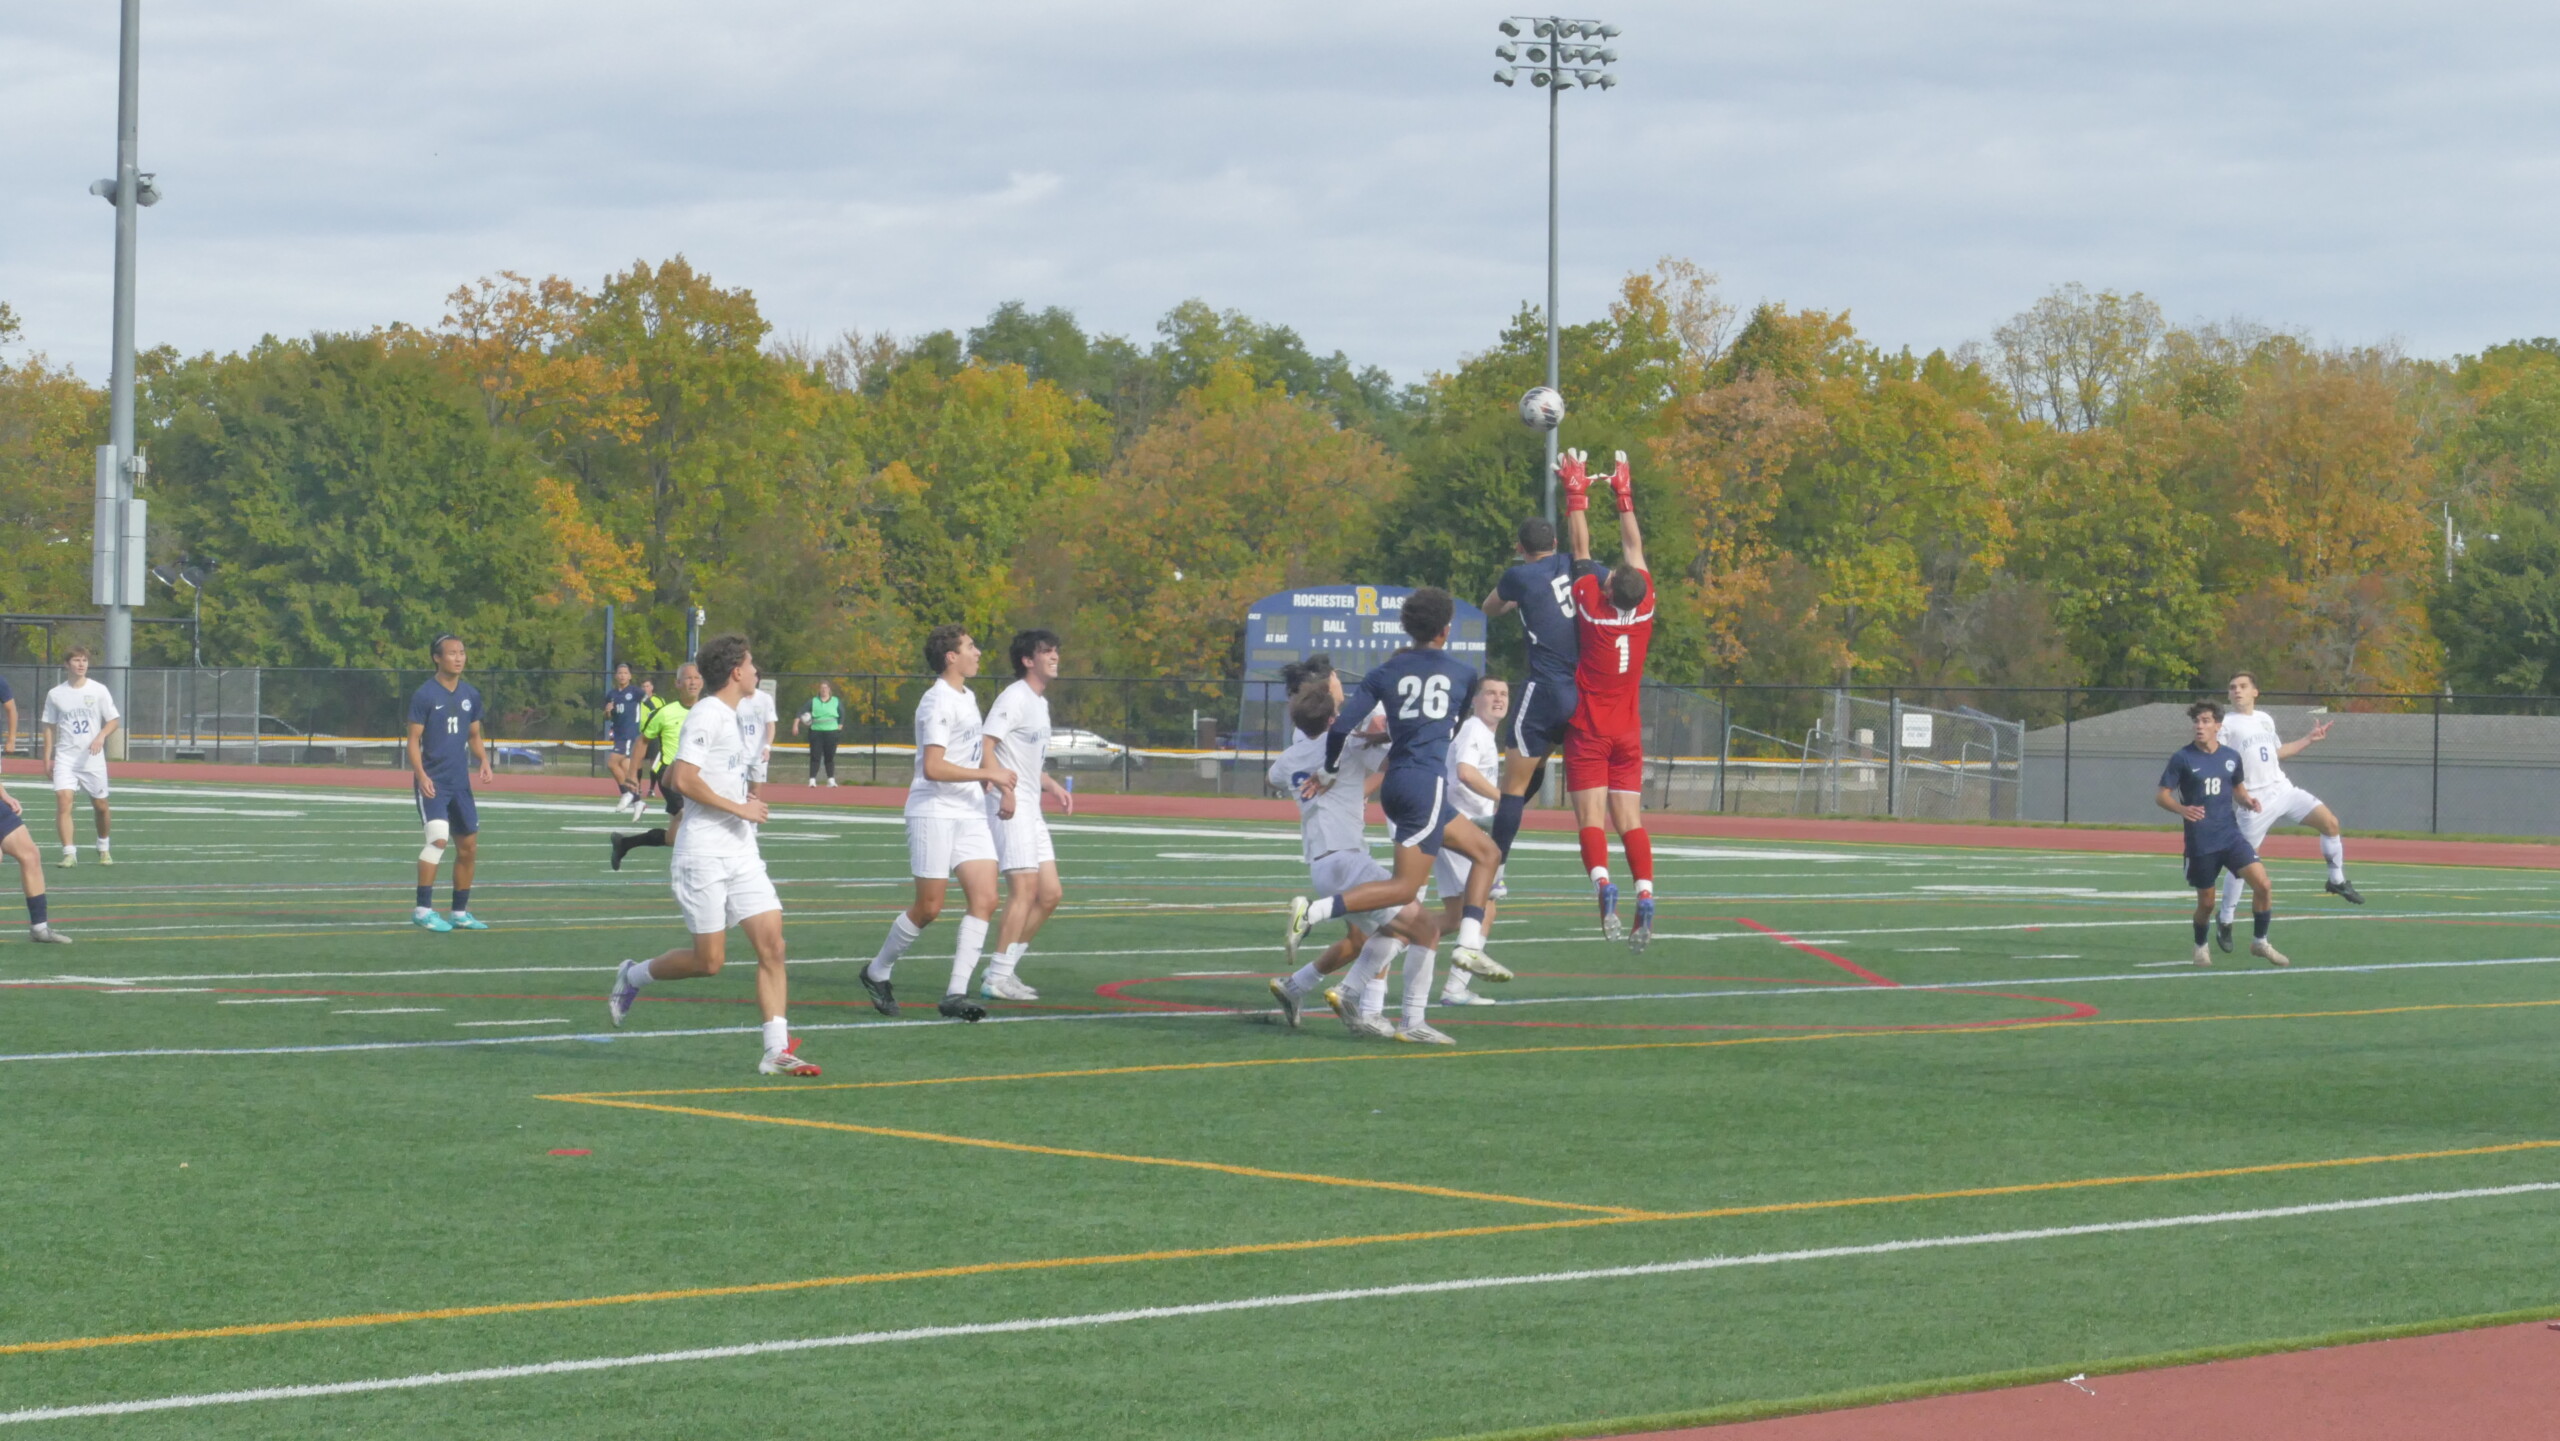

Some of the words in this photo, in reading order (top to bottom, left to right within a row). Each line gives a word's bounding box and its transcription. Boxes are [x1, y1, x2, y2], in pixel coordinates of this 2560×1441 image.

[1293, 594, 1355, 608] ROCHESTER
[1355, 586, 1379, 615] R
[1551, 574, 1576, 618] 5
[1323, 620, 1347, 633] BALL
[1265, 634, 1274, 643] AT
[1275, 634, 1288, 643] BAT
[1311, 639, 1316, 647] 1
[1323, 639, 1328, 648] 2
[1335, 639, 1341, 648] 3
[1347, 640, 1352, 648] 4
[1359, 640, 1365, 648] 5
[1371, 640, 1376, 648] 6
[1383, 640, 1388, 648] 7
[1615, 634, 1630, 674] 1
[1397, 674, 1451, 720] 26
[616, 703, 625, 714] 10
[73, 720, 89, 734] 32
[447, 716, 459, 734] 11
[744, 724, 756, 736] 19
[2260, 746, 2269, 763] 6
[2204, 777, 2221, 795] 18
